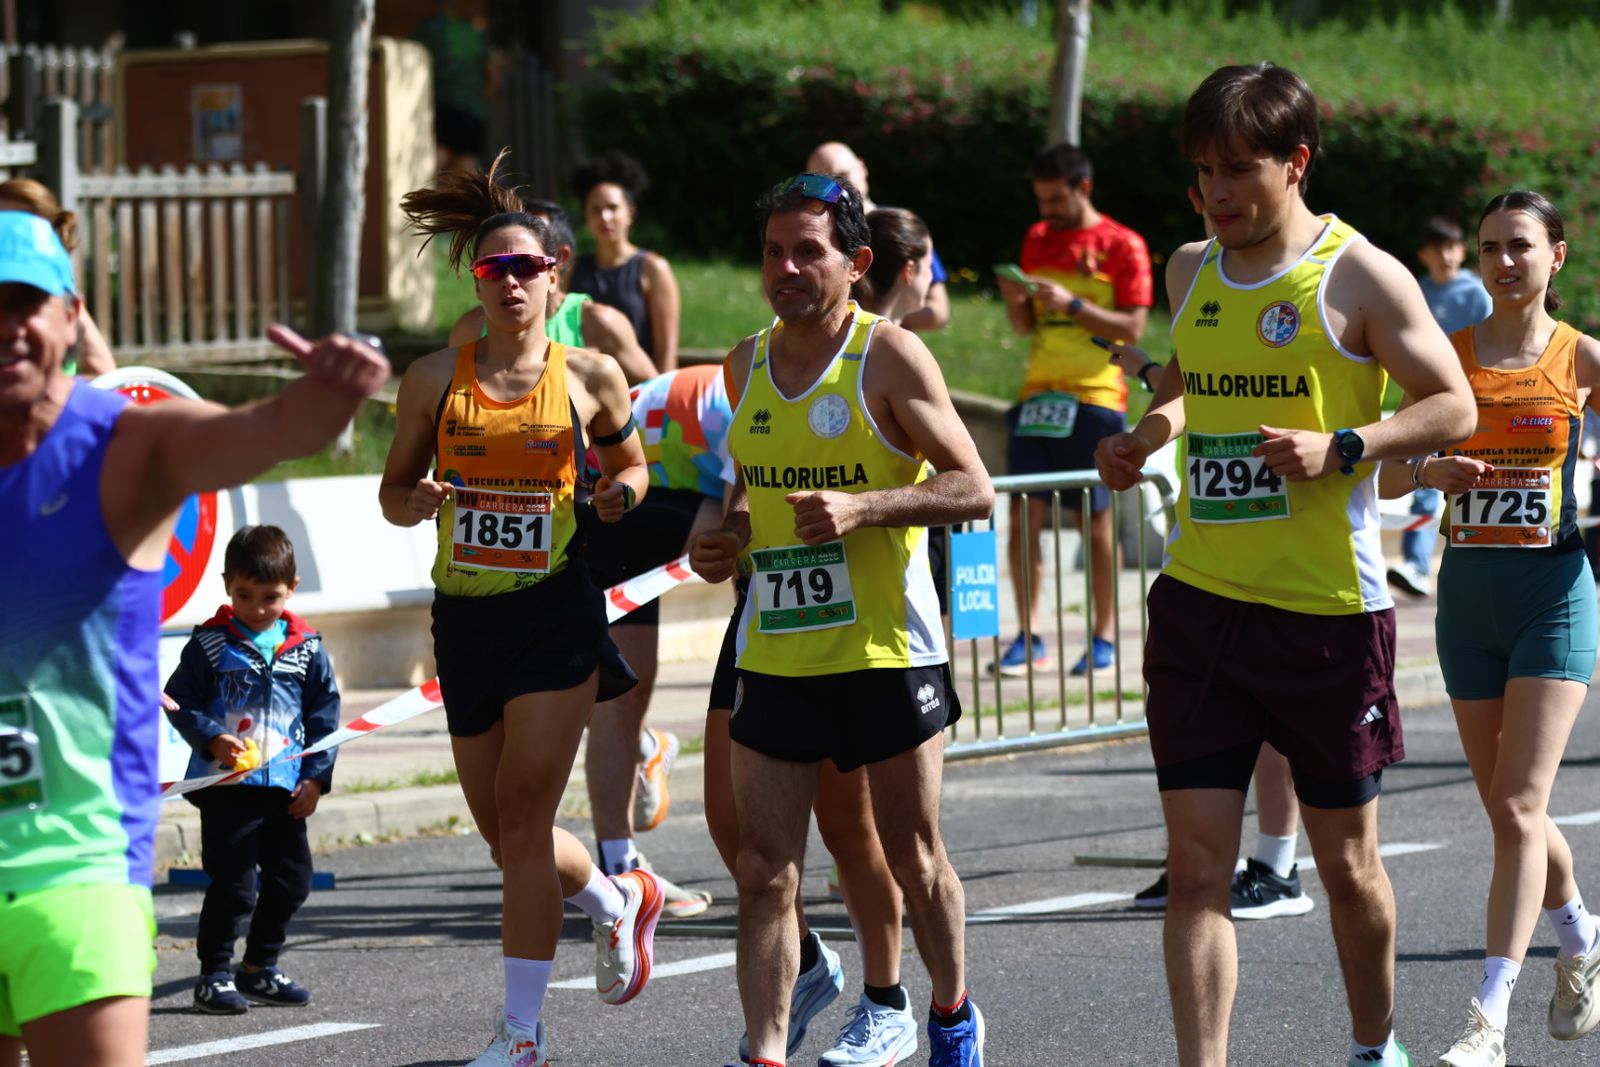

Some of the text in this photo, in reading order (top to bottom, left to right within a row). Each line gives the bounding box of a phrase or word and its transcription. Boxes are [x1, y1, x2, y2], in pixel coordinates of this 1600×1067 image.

[1195, 318, 1219, 327] errea
[1184, 371, 1310, 398] VILLORUELA
[749, 425, 771, 434] errea
[1202, 445, 1249, 456] CARRERA
[1464, 447, 1504, 456] ESCUELA
[467, 477, 514, 487] ESCUELA
[742, 462, 869, 489] VILLORUELA
[1190, 459, 1282, 497] 1294
[480, 500, 525, 512] CARRERA
[1455, 490, 1547, 525] 1725
[458, 510, 544, 549] 1851
[773, 554, 817, 568] CARRERA
[766, 567, 834, 609] 719
[958, 589, 995, 612] LOCAL
[920, 697, 940, 714] errea
